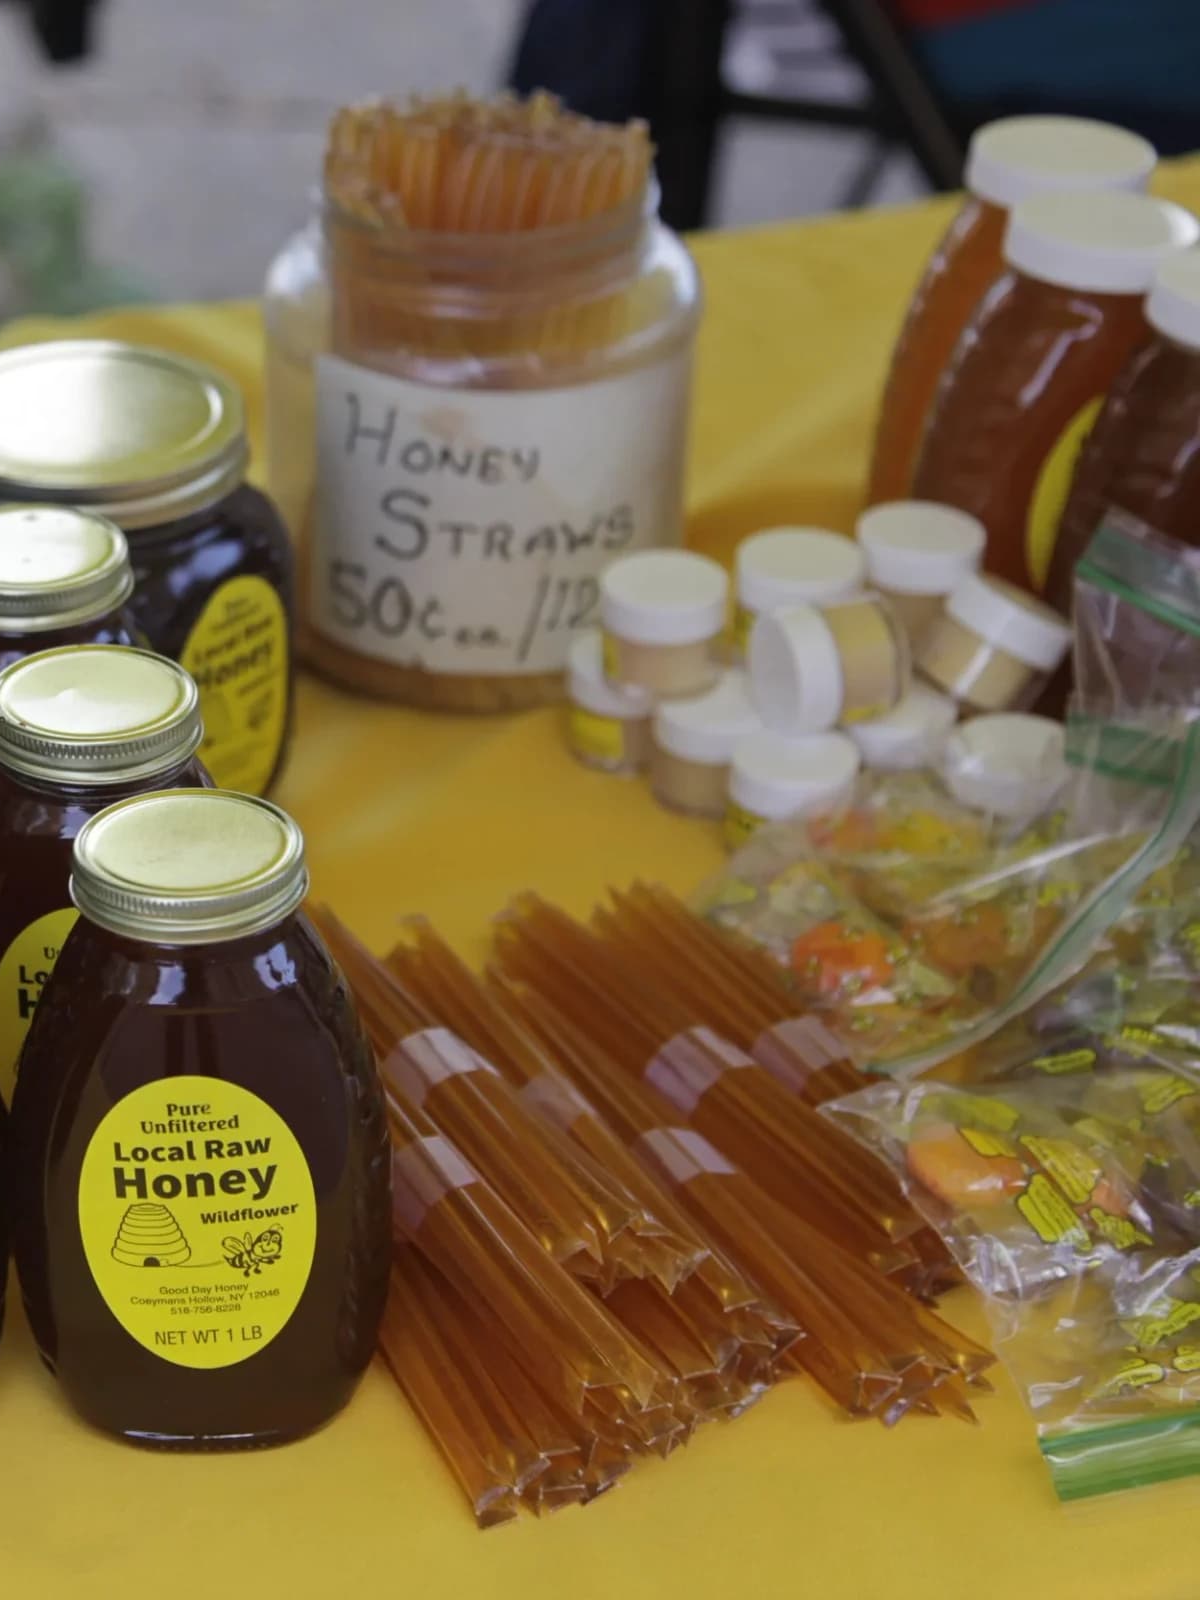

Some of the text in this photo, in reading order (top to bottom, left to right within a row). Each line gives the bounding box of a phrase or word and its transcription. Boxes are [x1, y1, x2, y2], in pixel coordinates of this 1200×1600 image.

[166, 1103, 211, 1117] Pure
[141, 1115, 239, 1134] Unfiltered
[113, 1137, 271, 1162] Local Raw
[113, 1164, 278, 1201] Honey
[200, 1203, 298, 1225] Wildflower
[159, 1283, 249, 1295] Good Day Honey
[230, 1293, 245, 1301] NY
[154, 1325, 263, 1346] NET WT 1 LB
